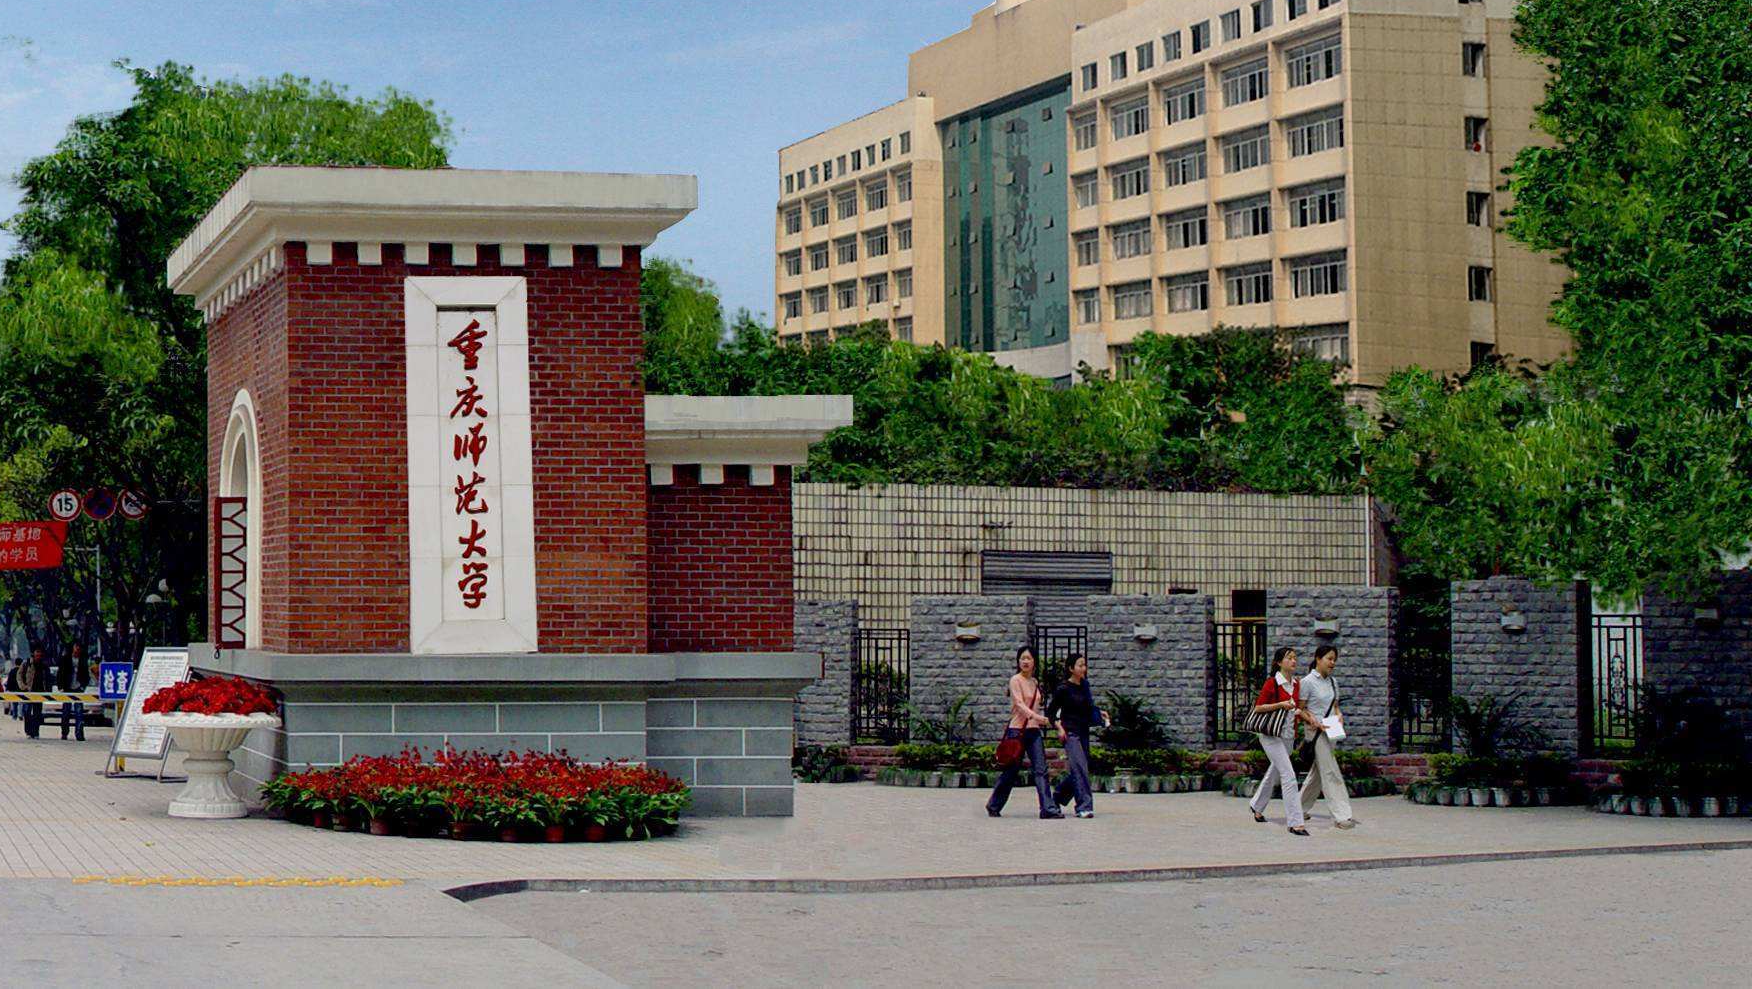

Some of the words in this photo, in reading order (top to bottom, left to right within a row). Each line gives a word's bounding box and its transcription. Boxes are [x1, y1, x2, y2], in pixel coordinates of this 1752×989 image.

[448, 319, 489, 609] 重庆师范大学
[57, 497, 73, 512] 15
[104, 669, 128, 694] 检查
